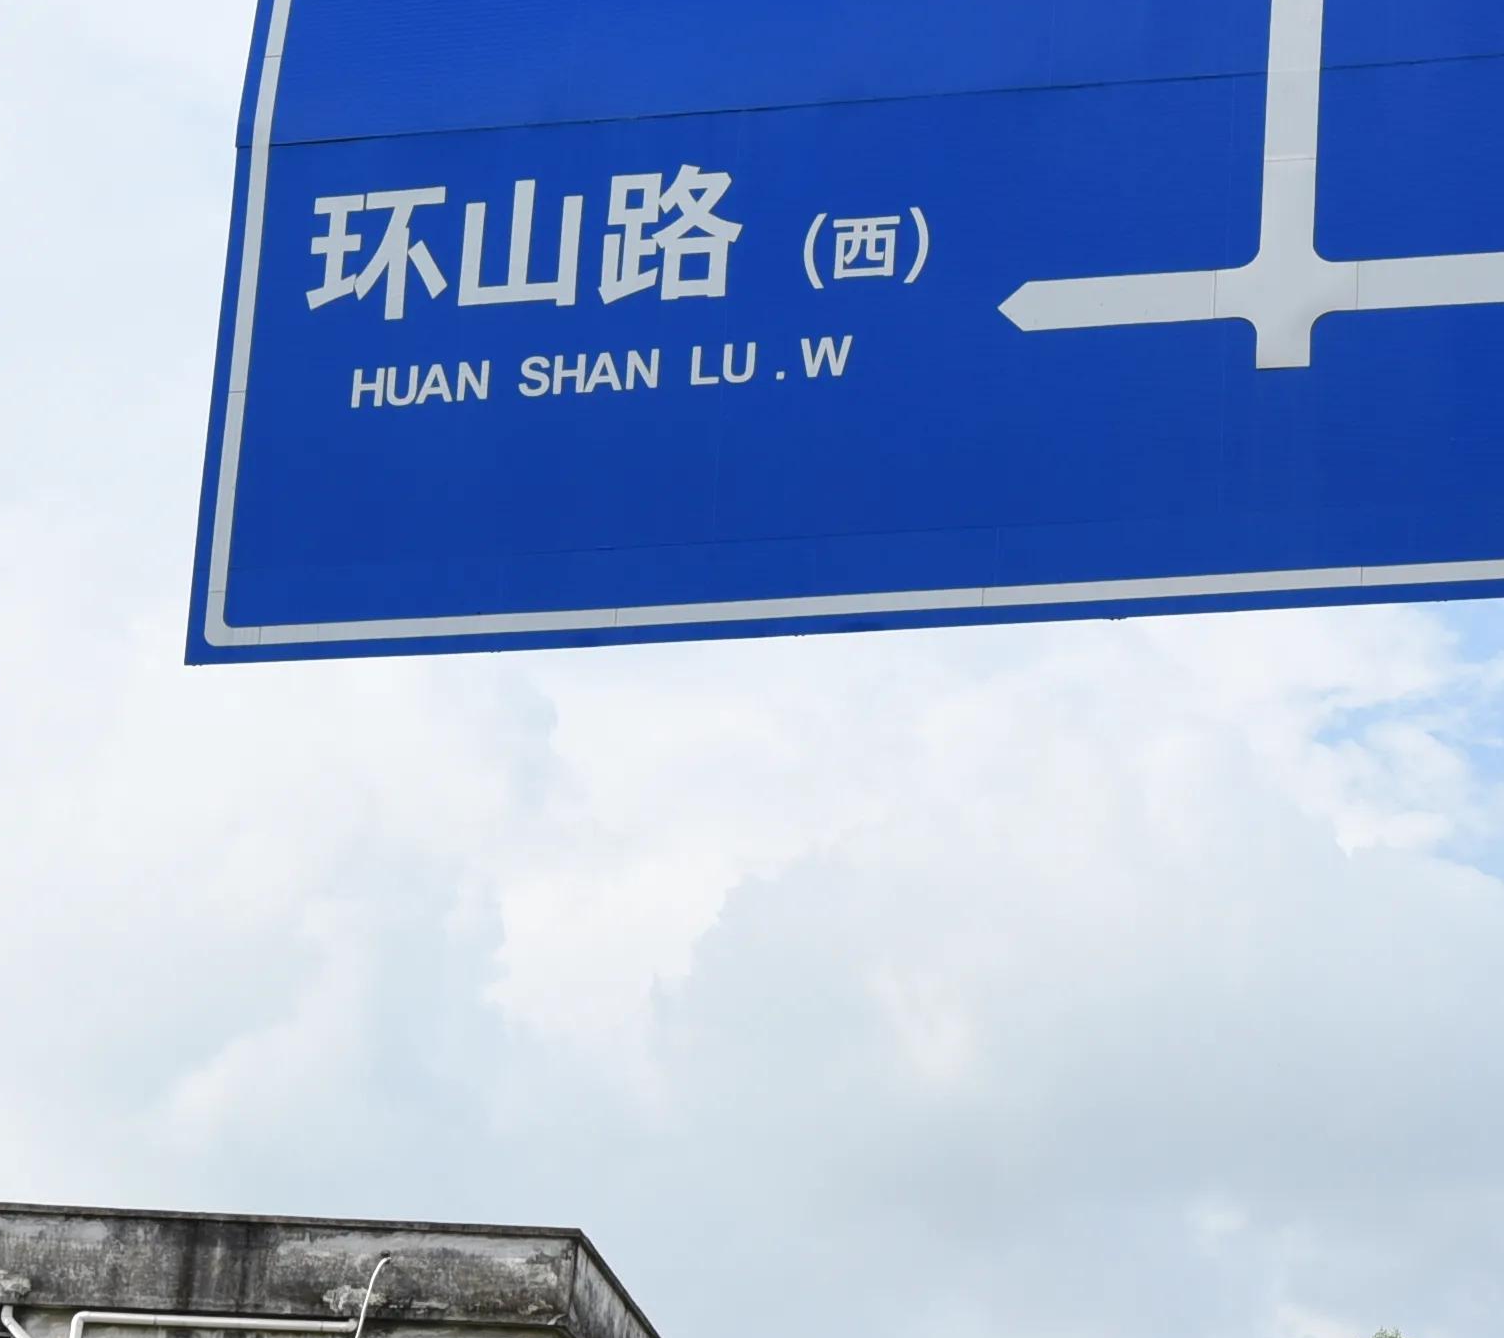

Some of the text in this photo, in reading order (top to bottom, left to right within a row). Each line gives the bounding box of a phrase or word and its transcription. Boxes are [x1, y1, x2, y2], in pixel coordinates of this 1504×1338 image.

[304, 162, 744, 322] 环山路
[349, 359, 491, 410] HUAN
[517, 347, 661, 398] SHAN
